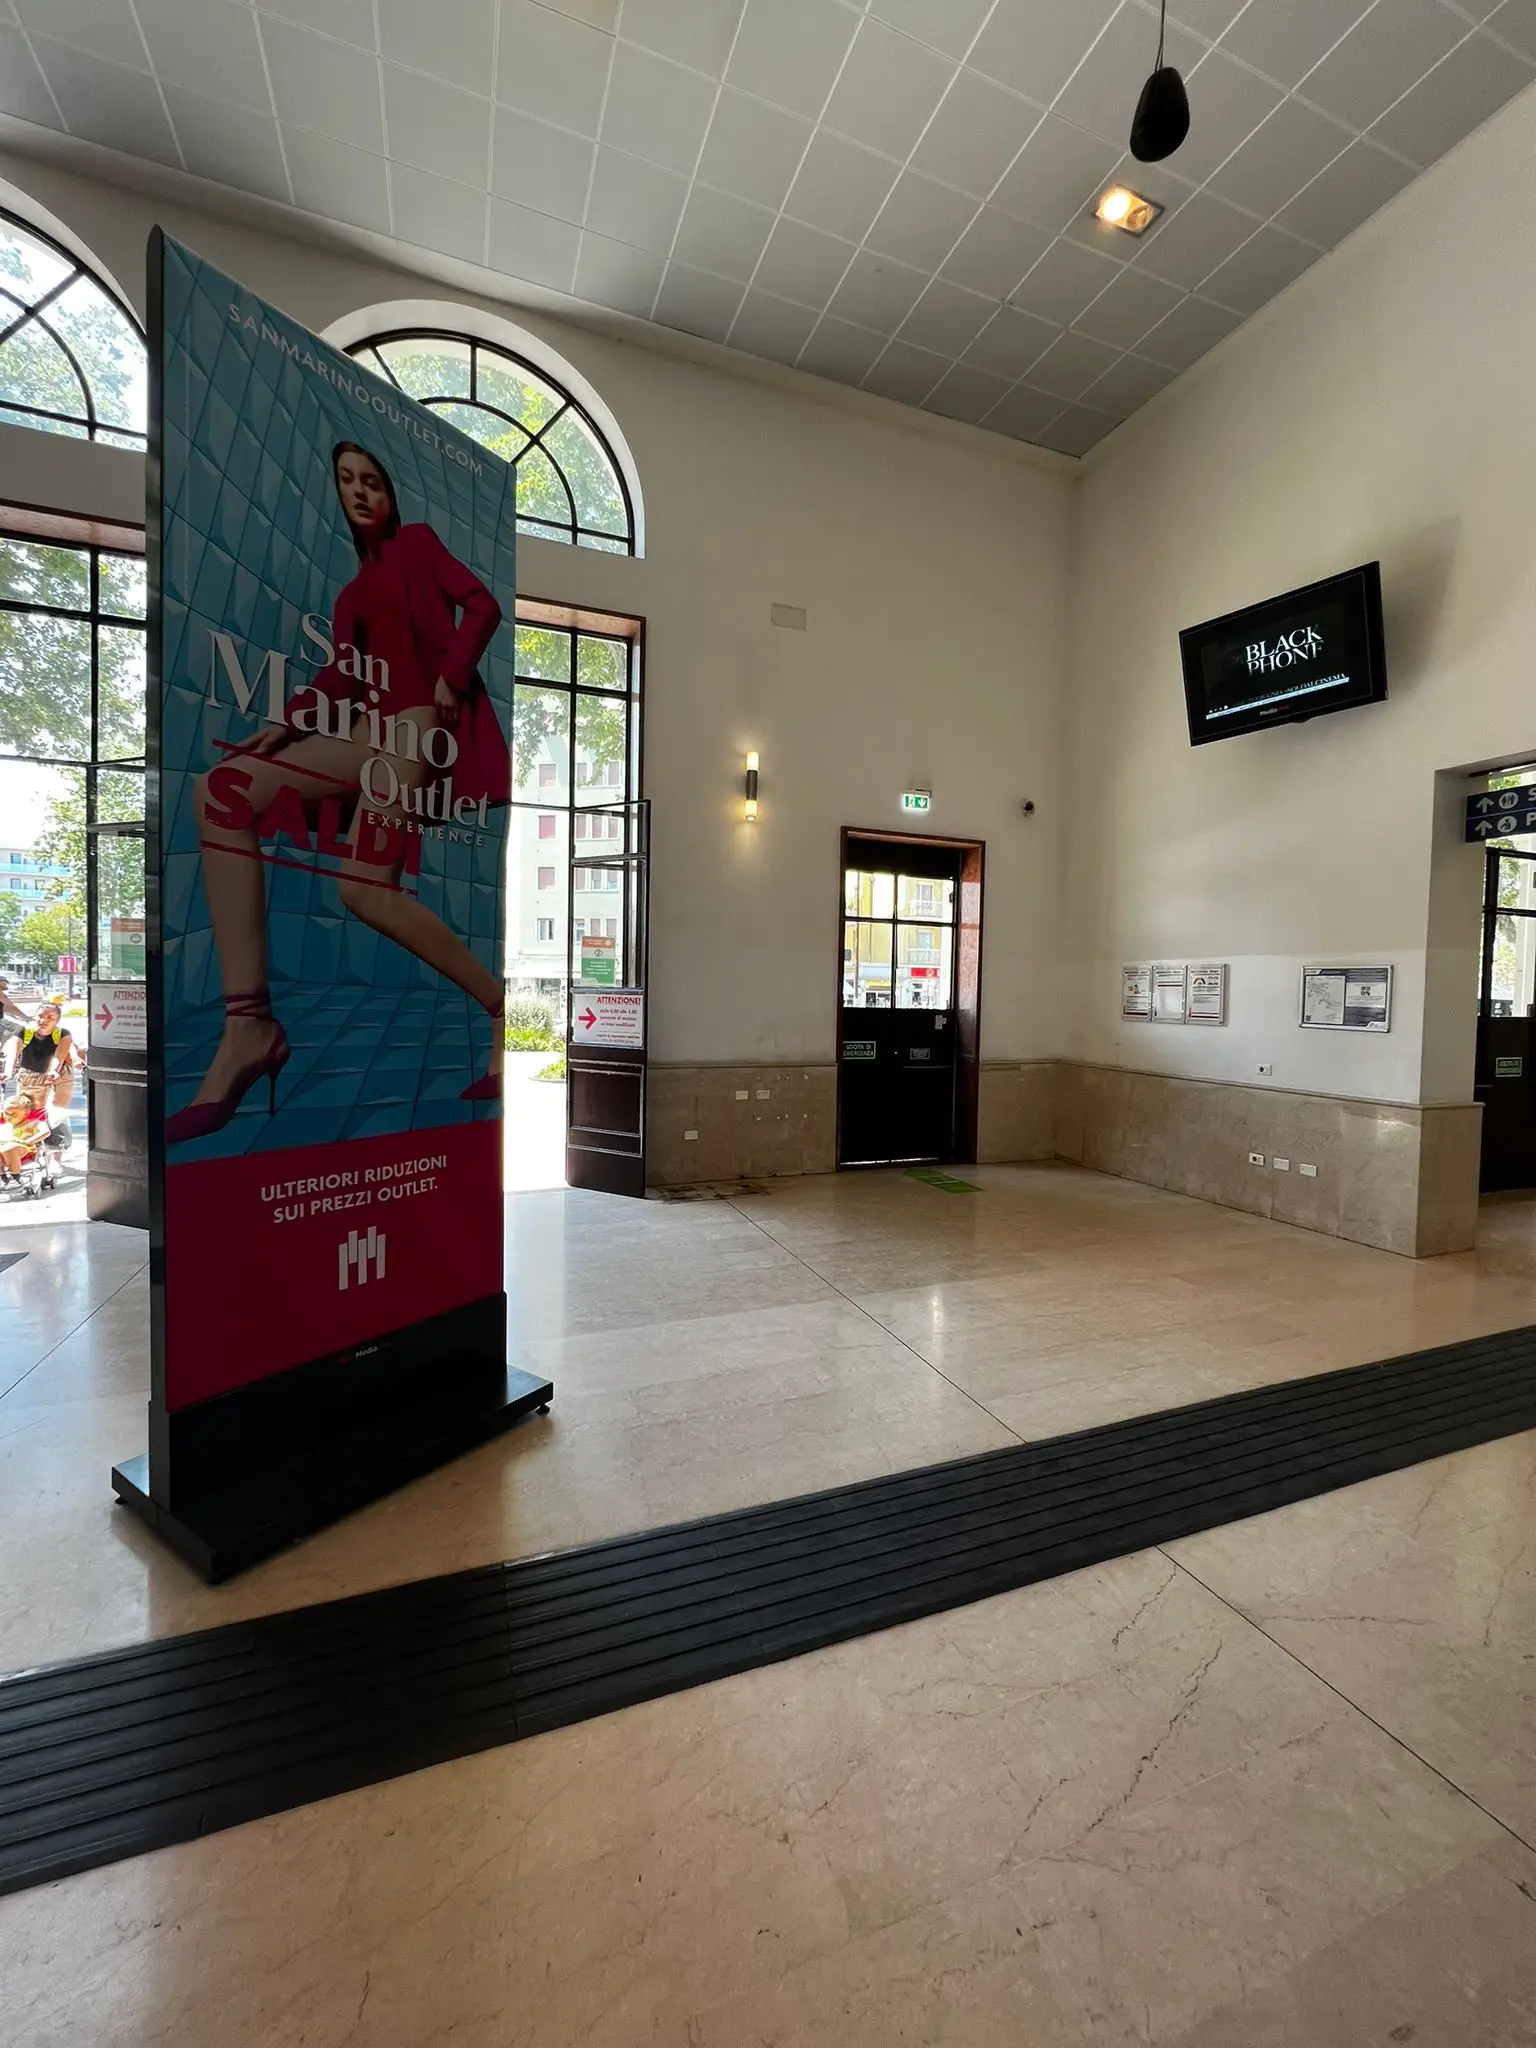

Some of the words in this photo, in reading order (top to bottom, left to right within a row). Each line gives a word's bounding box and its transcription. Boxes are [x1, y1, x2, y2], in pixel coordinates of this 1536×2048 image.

[229, 303, 482, 477] SANMARINOOUTLET.COM
[300, 612, 391, 692] San
[1245, 624, 1322, 662] BLACK
[205, 628, 459, 769] Marino
[204, 766, 421, 876] SALDI
[359, 756, 492, 829] Outlet
[367, 812, 484, 846] EXPERIENCE
[596, 996, 641, 1005] ATTENZIONE!
[261, 1171, 359, 1202] ULTERIORI
[364, 1155, 447, 1183] RIDUZIONI
[273, 1203, 305, 1224] SUI
[311, 1190, 372, 1215] PREZZI
[377, 1177, 438, 1202] OUTLET.
